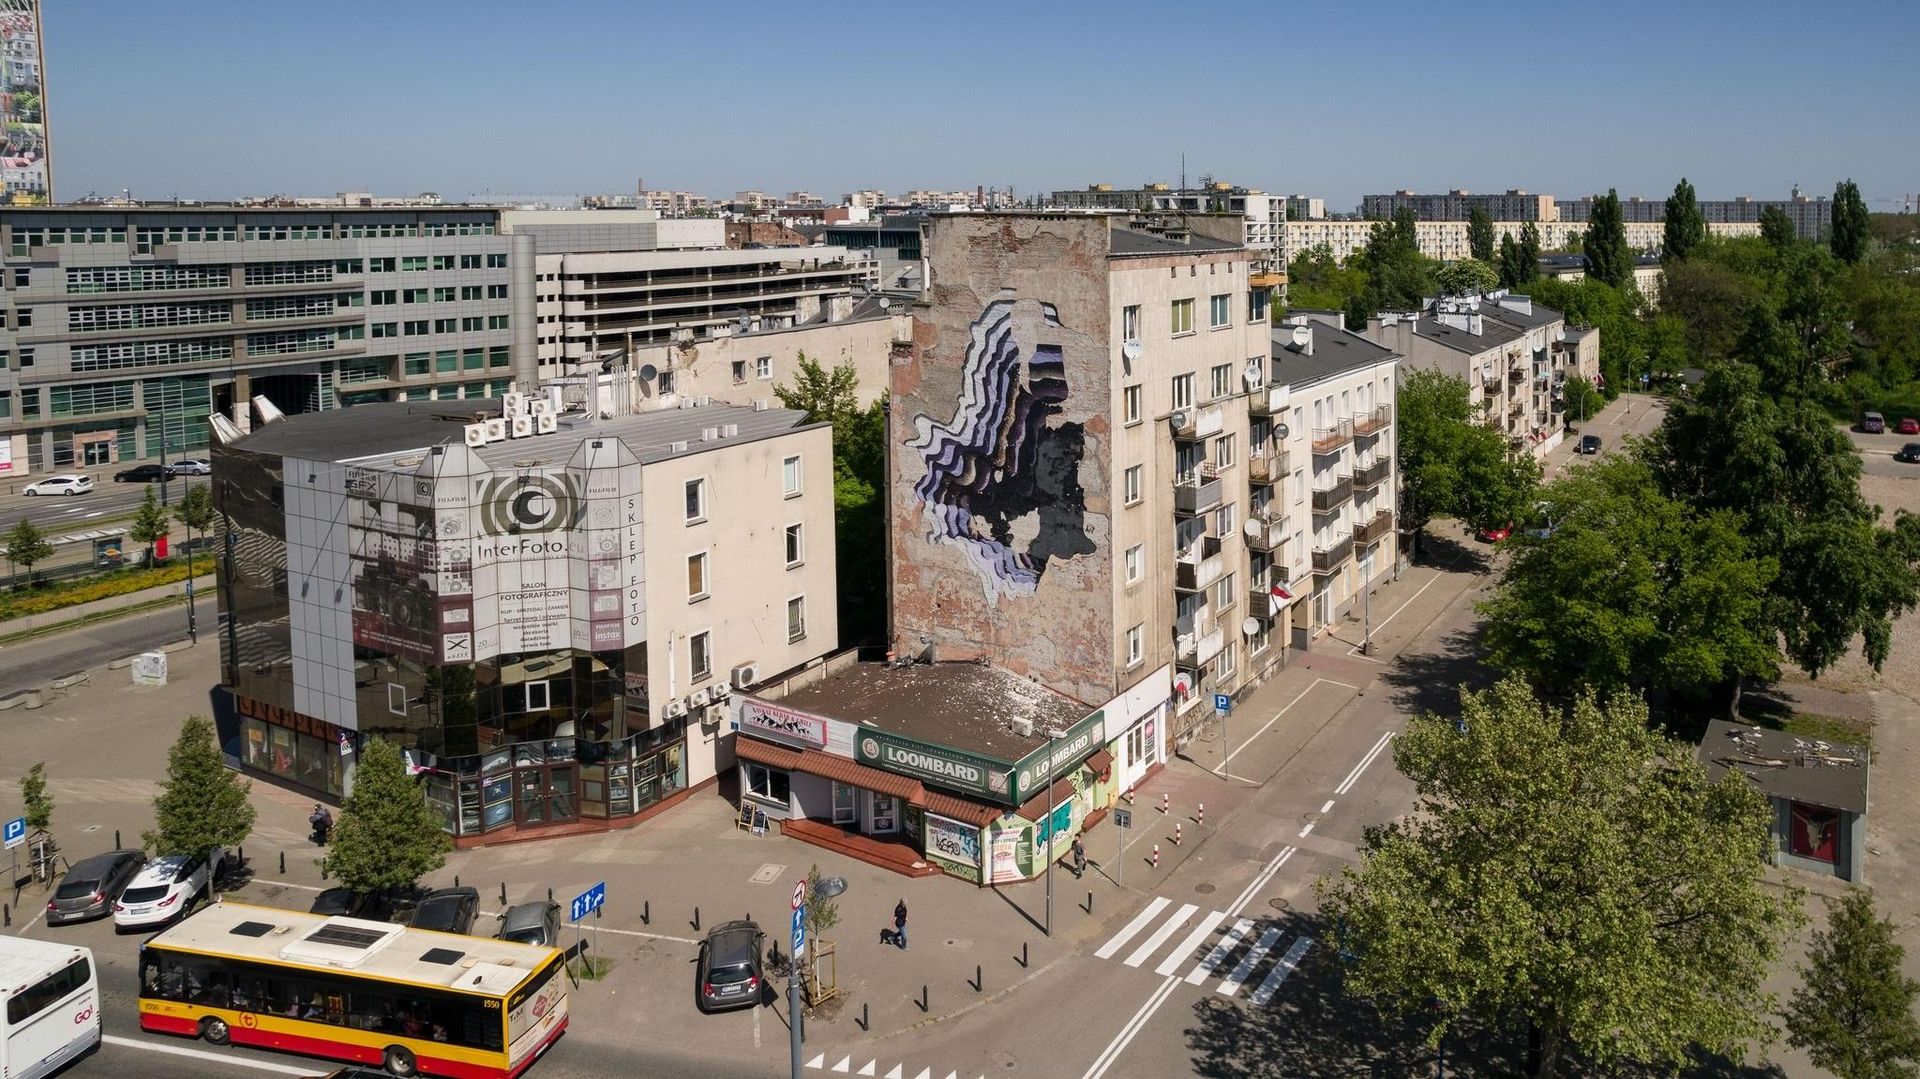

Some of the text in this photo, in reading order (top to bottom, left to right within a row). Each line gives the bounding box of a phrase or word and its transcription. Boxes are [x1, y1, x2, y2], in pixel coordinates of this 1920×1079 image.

[628, 499, 639, 626] SKLEP FOTO
[521, 582, 547, 590] SALON
[500, 590, 569, 601] FOTOGRAFICZNY
[595, 631, 621, 641] instax
[888, 747, 979, 782] LOOMBARD
[8, 821, 21, 838] P
[484, 1000, 500, 1008] 1550
